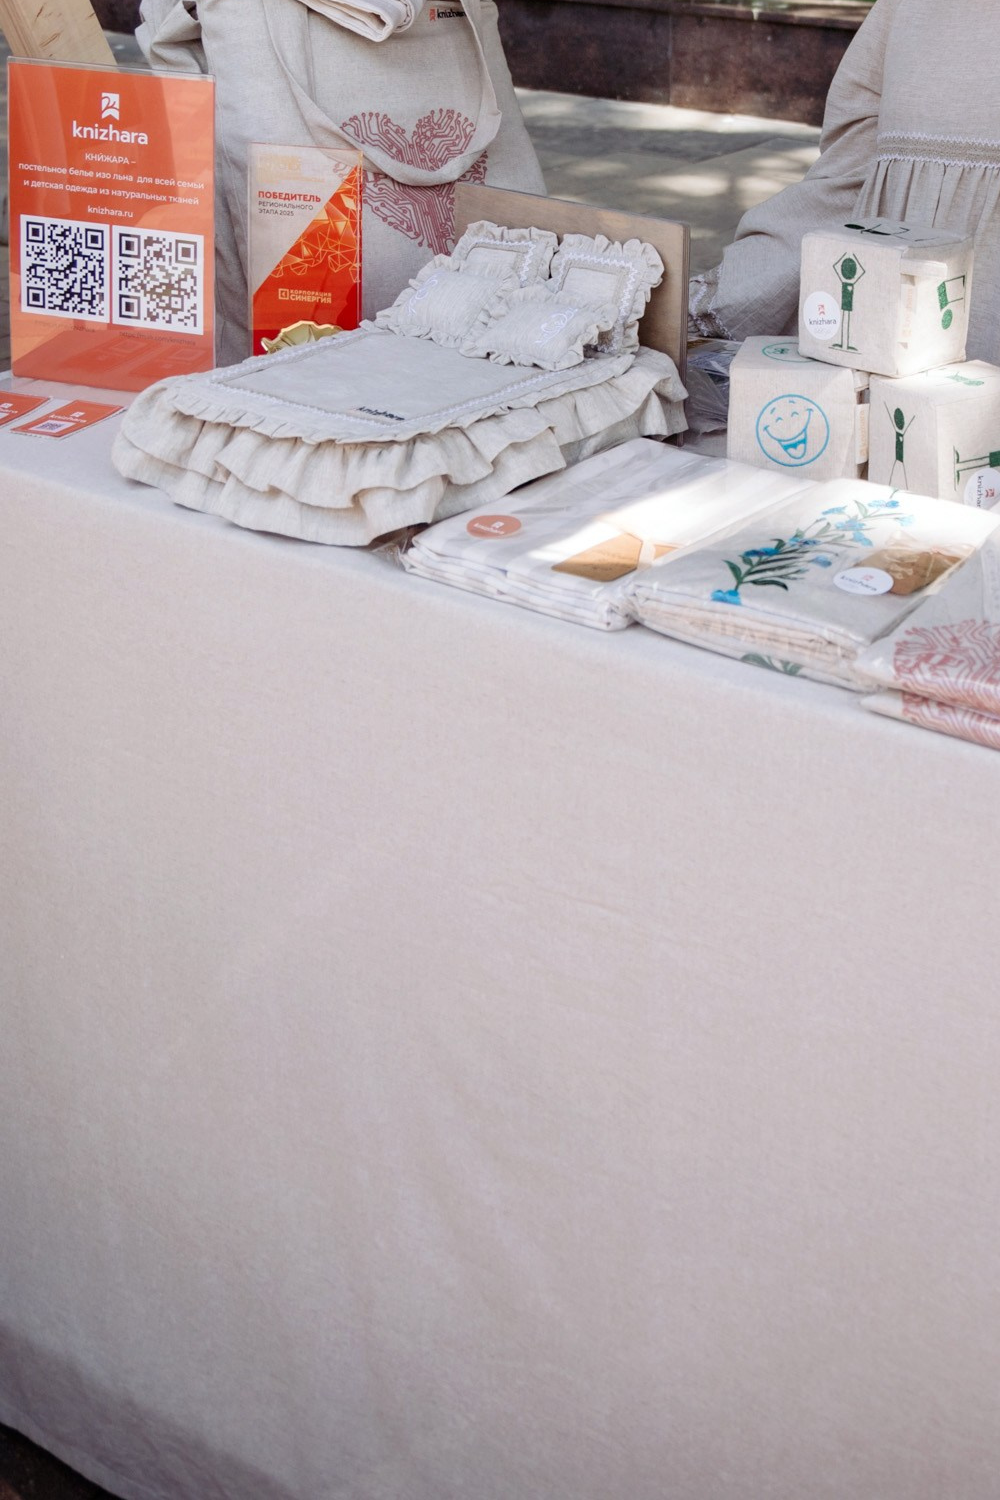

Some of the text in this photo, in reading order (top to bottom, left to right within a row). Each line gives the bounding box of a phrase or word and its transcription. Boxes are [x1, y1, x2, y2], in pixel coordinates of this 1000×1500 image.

[72, 120, 148, 145] knizhara
[18, 163, 204, 190] постельное белье изо льна для всей семьи
[23, 179, 199, 206] и детская одежда из натуральных тканей
[258, 191, 321, 203] ПОБЕДИТЕЛЬ
[87, 205, 134, 218] knizhara.ru
[258, 201, 314, 211] РЕГИОНАЛЬНОГО
[290, 289, 332, 297] КОРПОРАЦИЯ
[290, 294, 332, 304] СИНЕРГИЯ
[808, 317, 837, 326] knizhara
